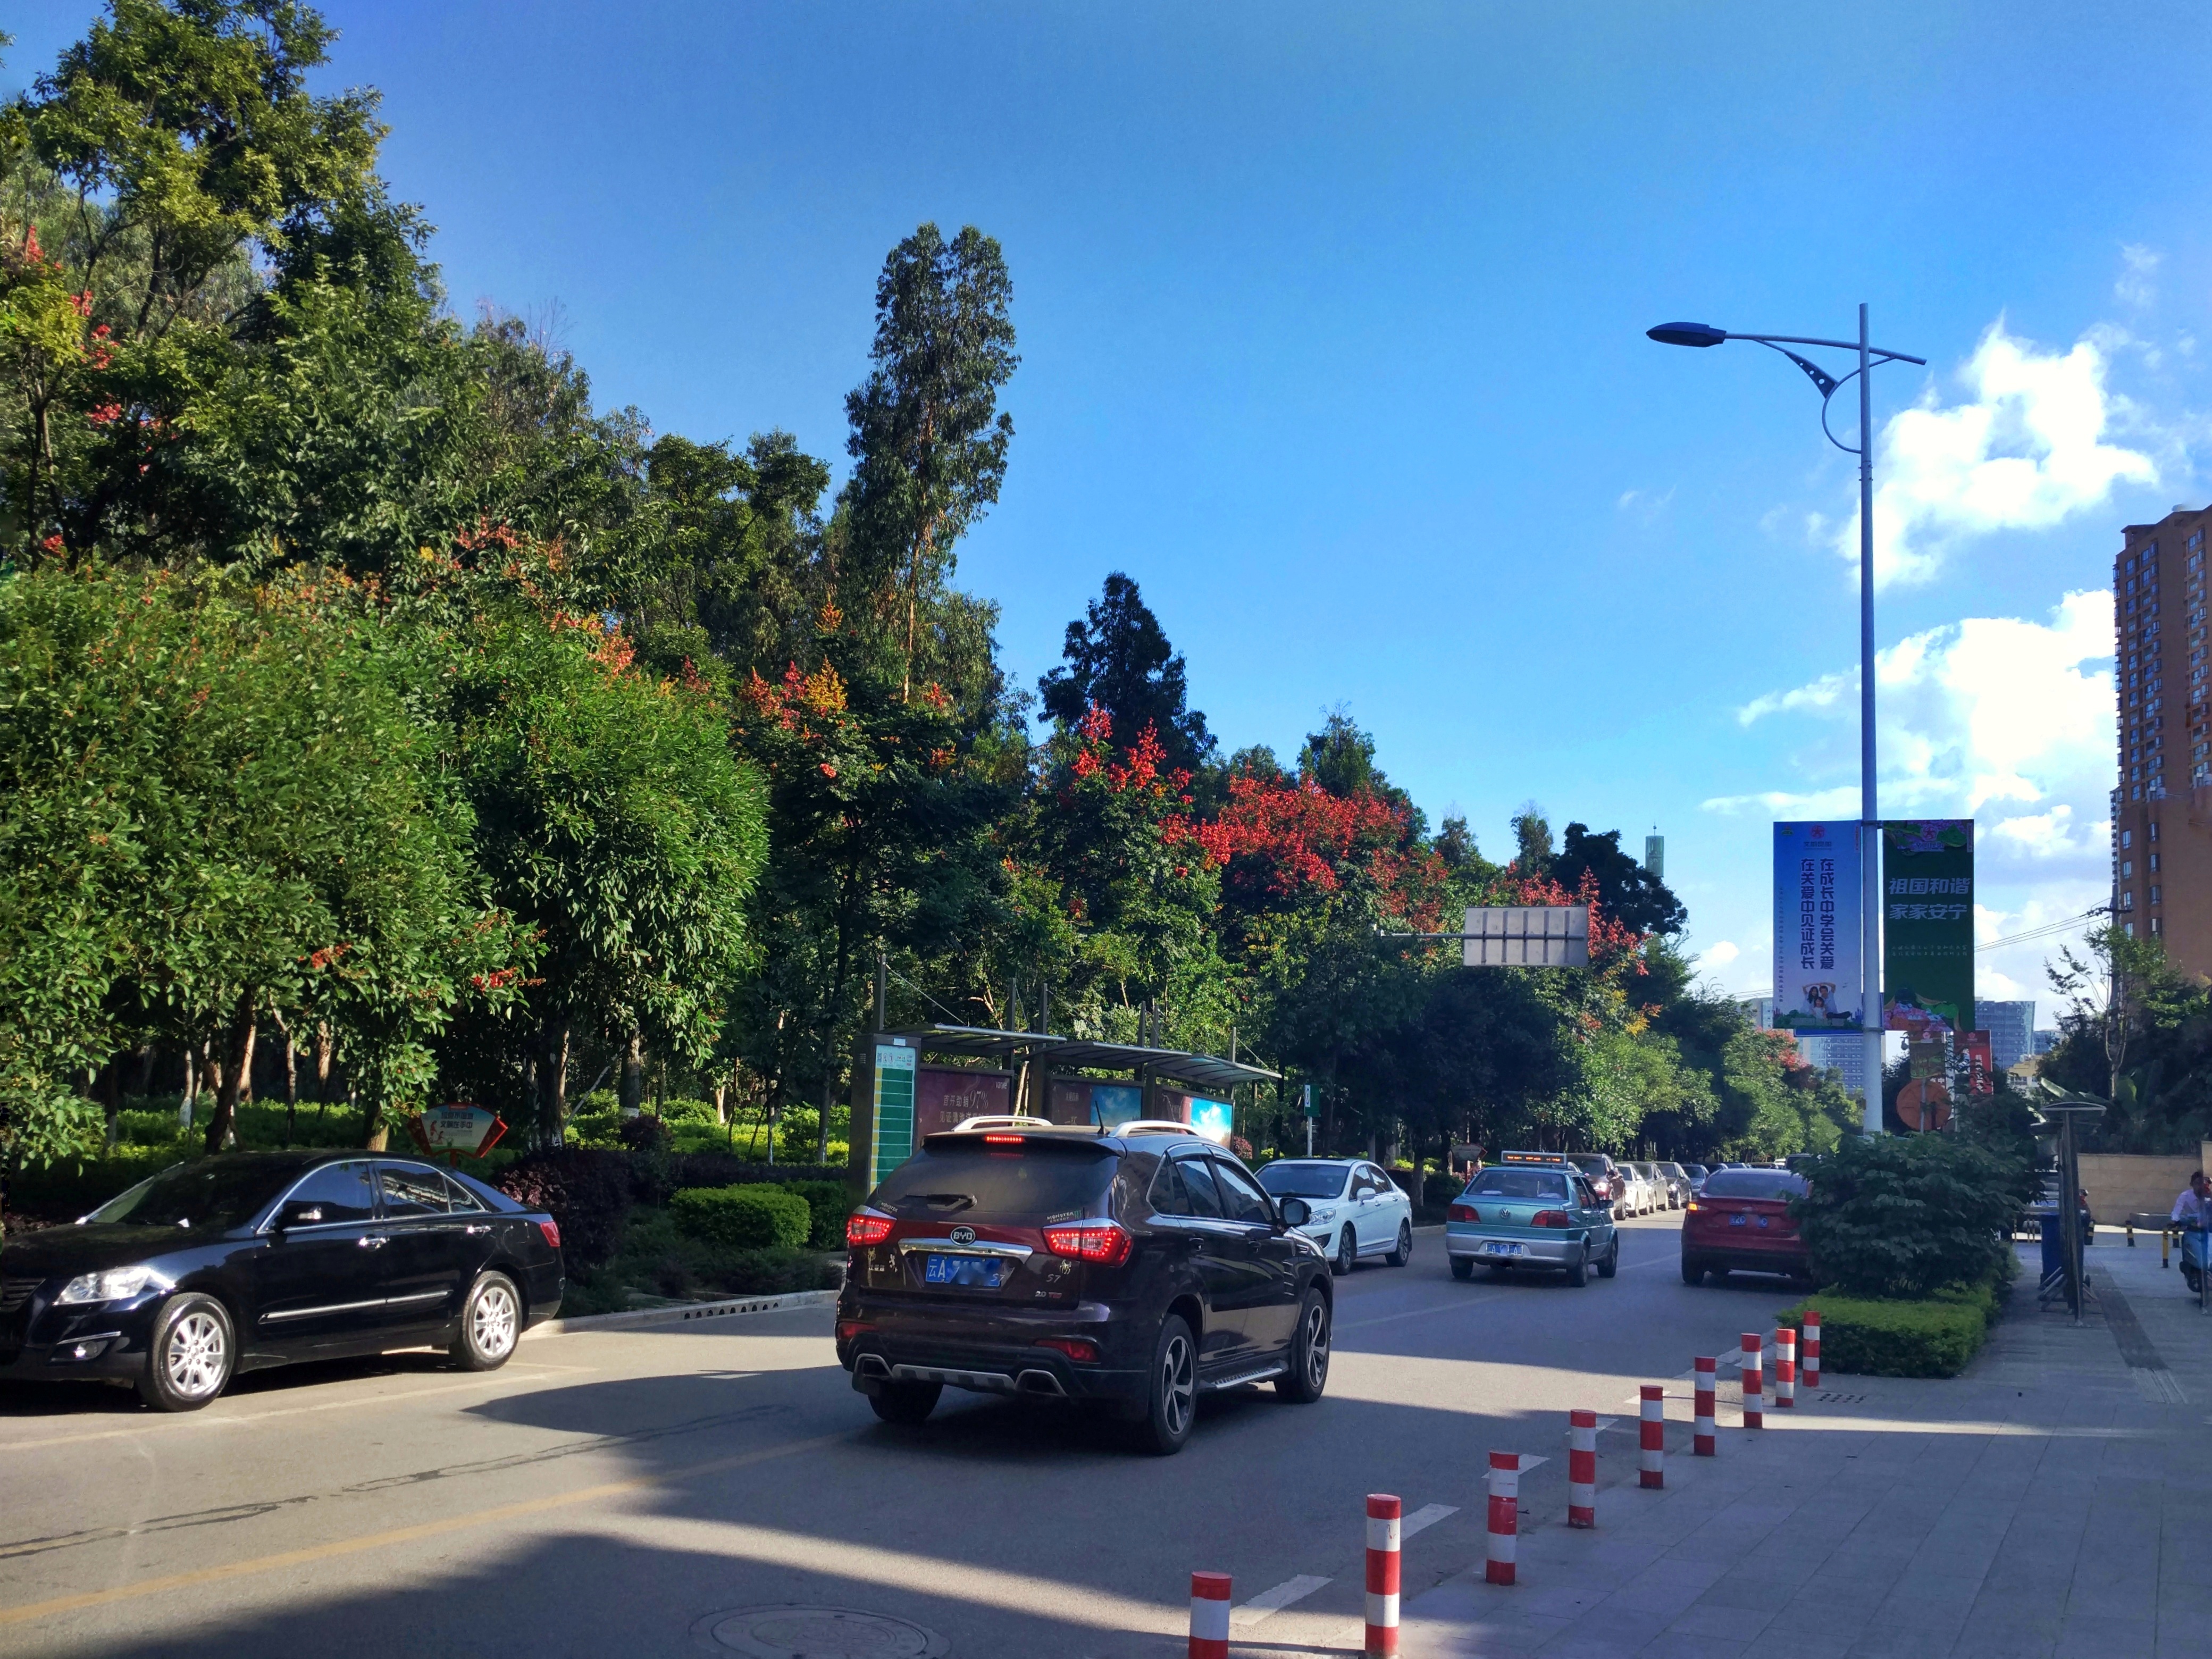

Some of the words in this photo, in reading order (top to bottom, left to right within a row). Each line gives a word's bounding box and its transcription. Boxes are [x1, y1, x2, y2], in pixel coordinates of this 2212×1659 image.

[1888, 878, 1971, 895] 祖国和谐
[1800, 858, 1815, 969] 在关爱中见证成长
[1820, 858, 1834, 969] 在成长中学会关爱
[1889, 903, 1967, 920] 家家安宁
[953, 1231, 973, 1240] BYD
